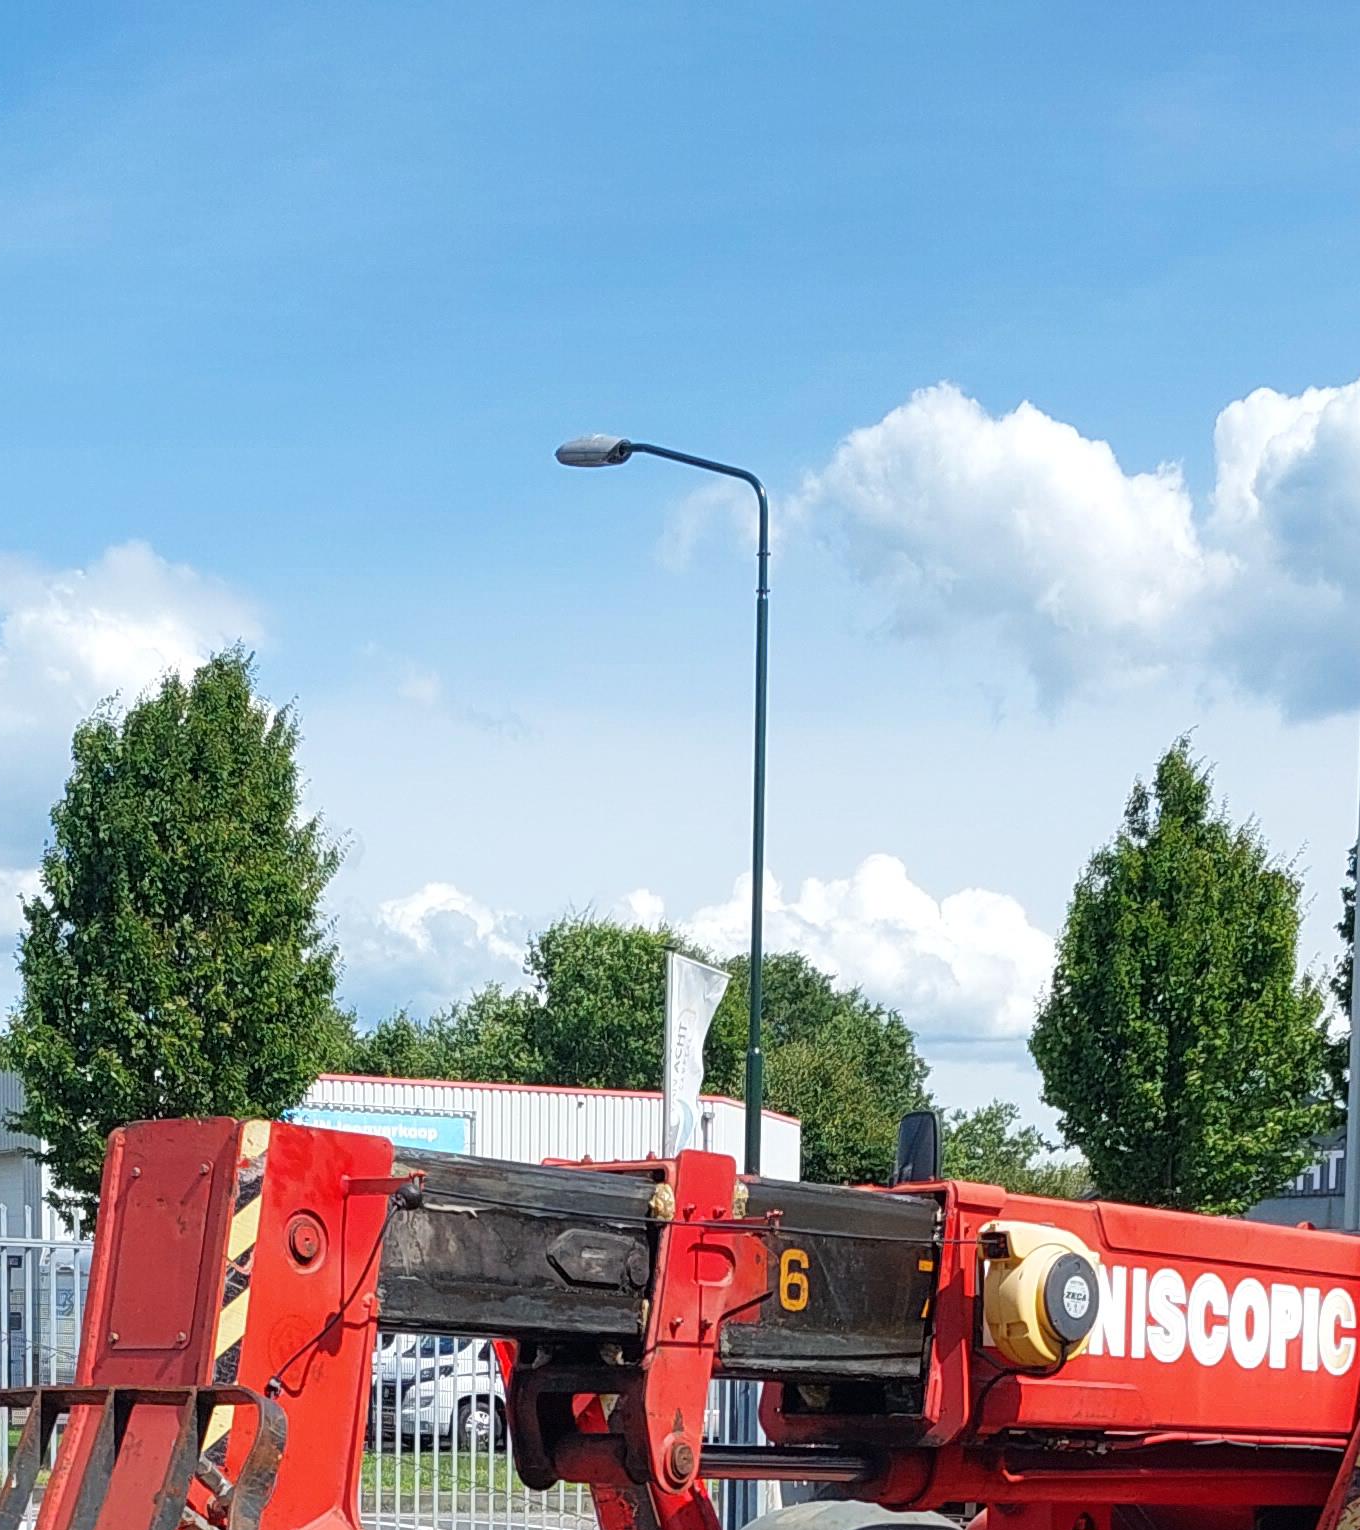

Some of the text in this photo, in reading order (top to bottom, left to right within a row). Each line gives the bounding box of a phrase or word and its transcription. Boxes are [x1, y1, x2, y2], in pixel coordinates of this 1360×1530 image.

[673, 1022, 687, 1074] ACHT
[780, 1248, 809, 1311] 6
[1065, 1291, 1087, 1302] ZECA
[983, 1260, 1357, 1376] NISCOPIC
